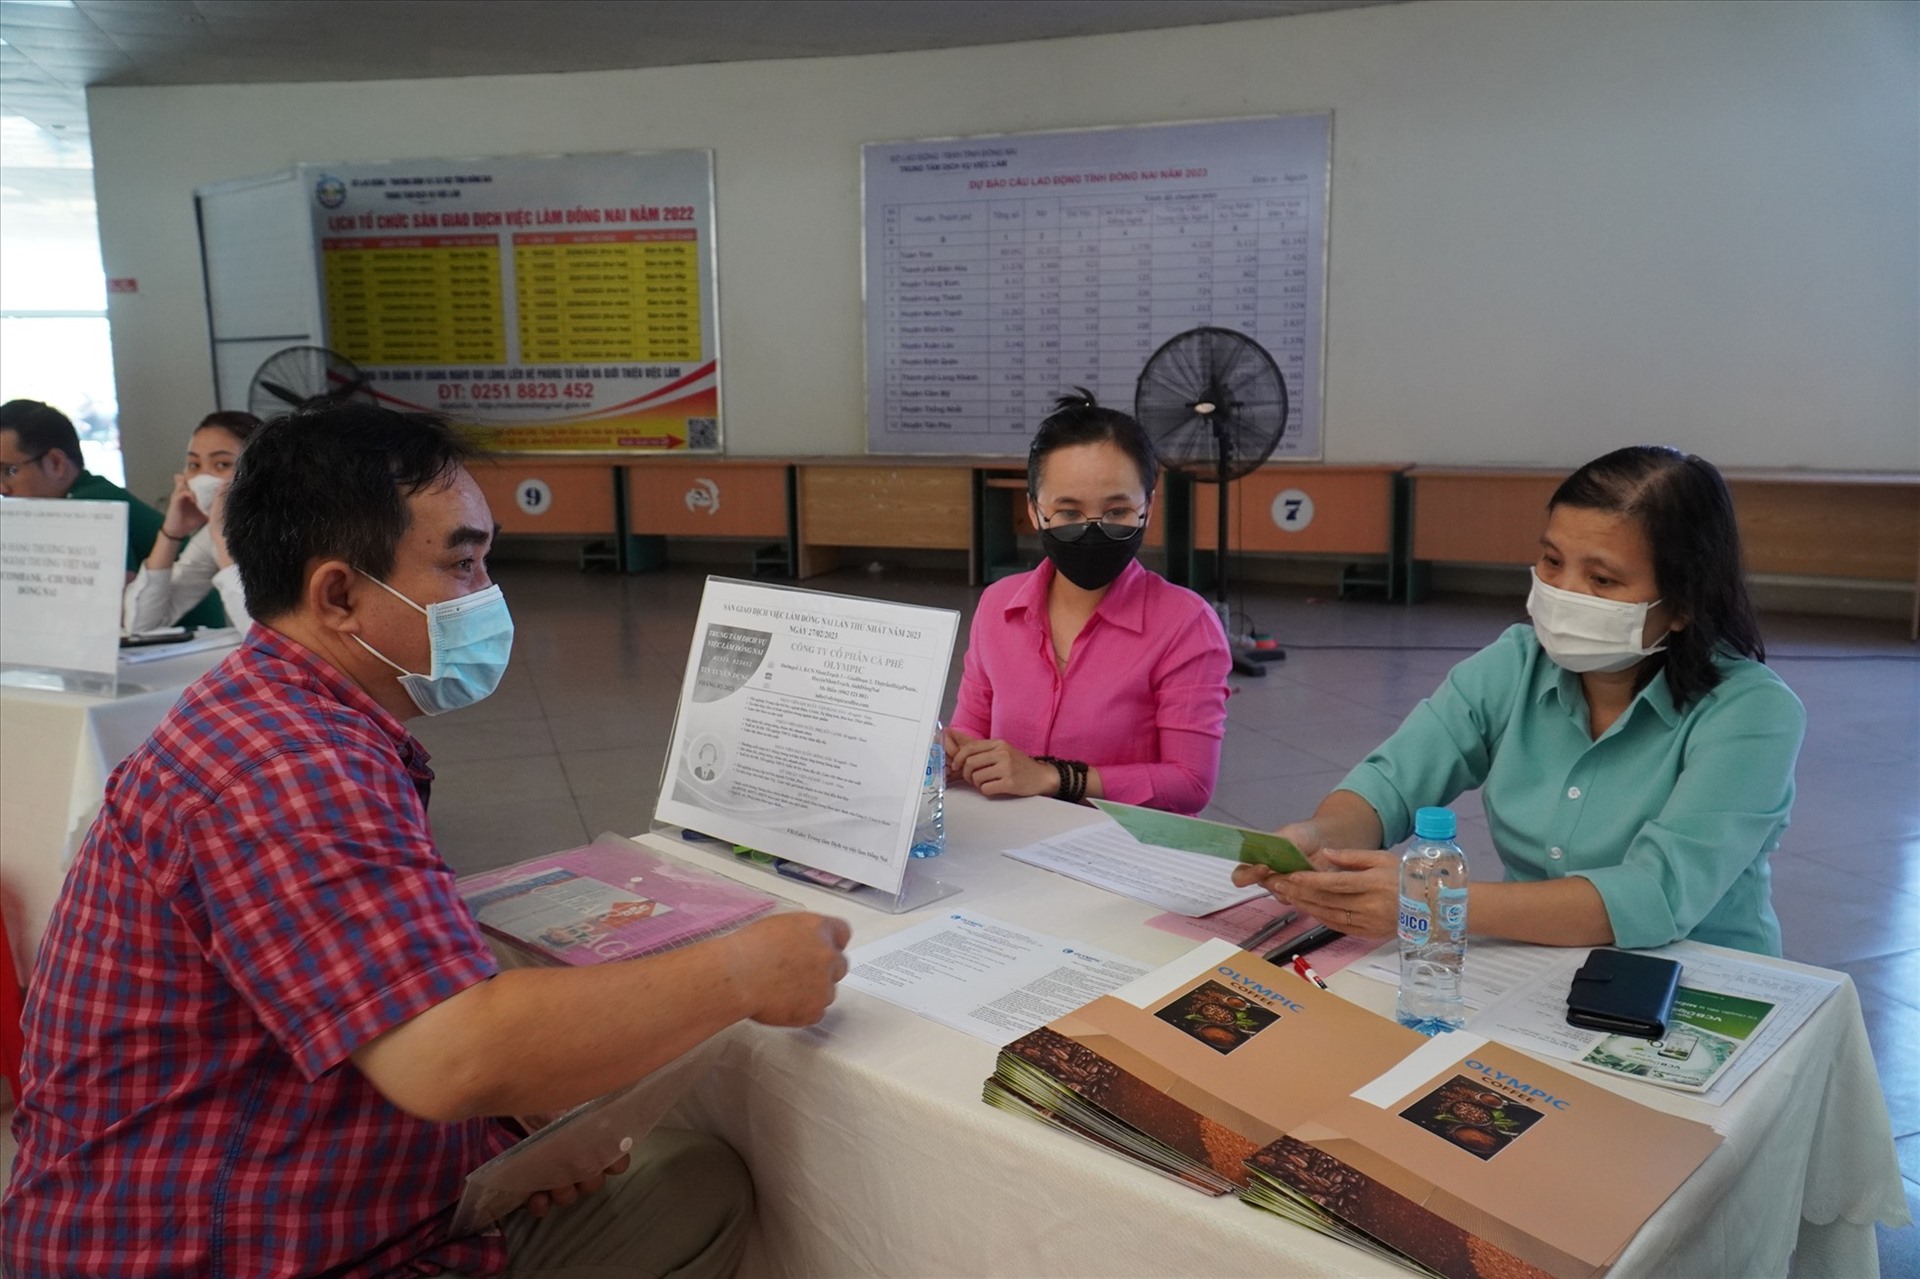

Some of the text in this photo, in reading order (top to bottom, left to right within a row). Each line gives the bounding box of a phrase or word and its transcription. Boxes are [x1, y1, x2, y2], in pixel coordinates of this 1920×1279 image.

[441, 211, 470, 228] GIAO
[535, 206, 563, 225] LÀM
[603, 208, 626, 222] NAI
[629, 202, 660, 222] NĂM
[662, 205, 695, 221] 2022
[437, 382, 594, 400] ĐT: 0251 8823 452
[525, 486, 542, 507] 9
[1285, 499, 1303, 521] 7
[808, 628, 839, 640] 27/02/2023
[906, 629, 922, 640] 2023
[790, 641, 816, 655] CÔNG
[817, 646, 829, 657] TY
[823, 659, 866, 675] OLYMPIC
[1217, 966, 1305, 1014] OLYMPIC
[1230, 981, 1276, 1007] COFFEE
[1465, 1059, 1571, 1111] OLYMPIC
[1481, 1076, 1536, 1105] COFFEE
